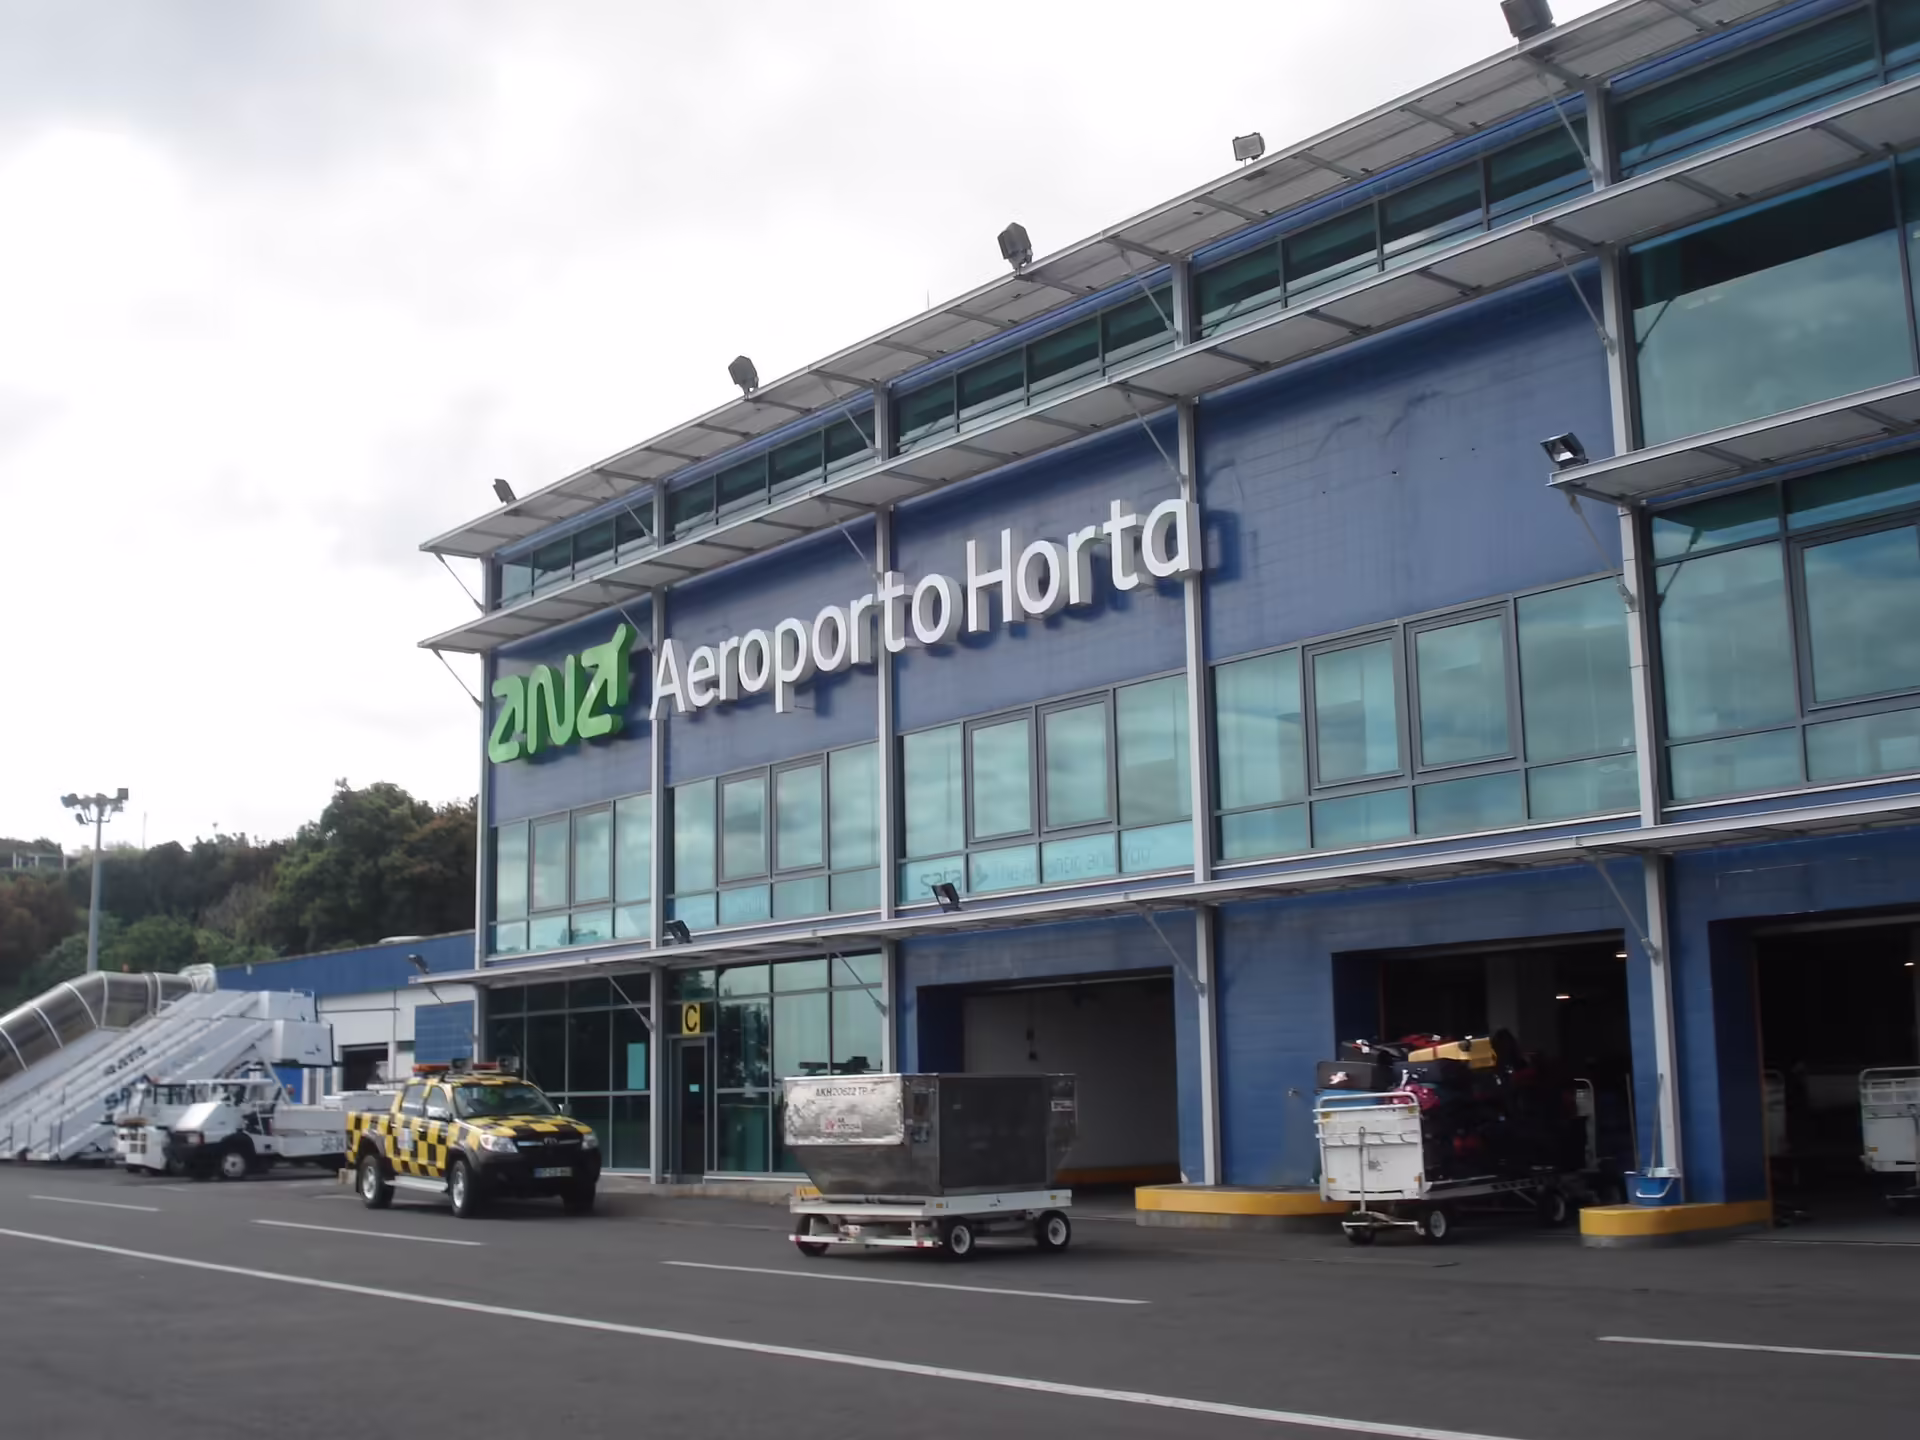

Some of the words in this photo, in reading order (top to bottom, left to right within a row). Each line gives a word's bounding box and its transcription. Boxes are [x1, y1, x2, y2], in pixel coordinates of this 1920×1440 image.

[650, 570, 963, 721] Aeroporto
[966, 498, 1202, 634] Horta
[685, 1004, 698, 1032] C
